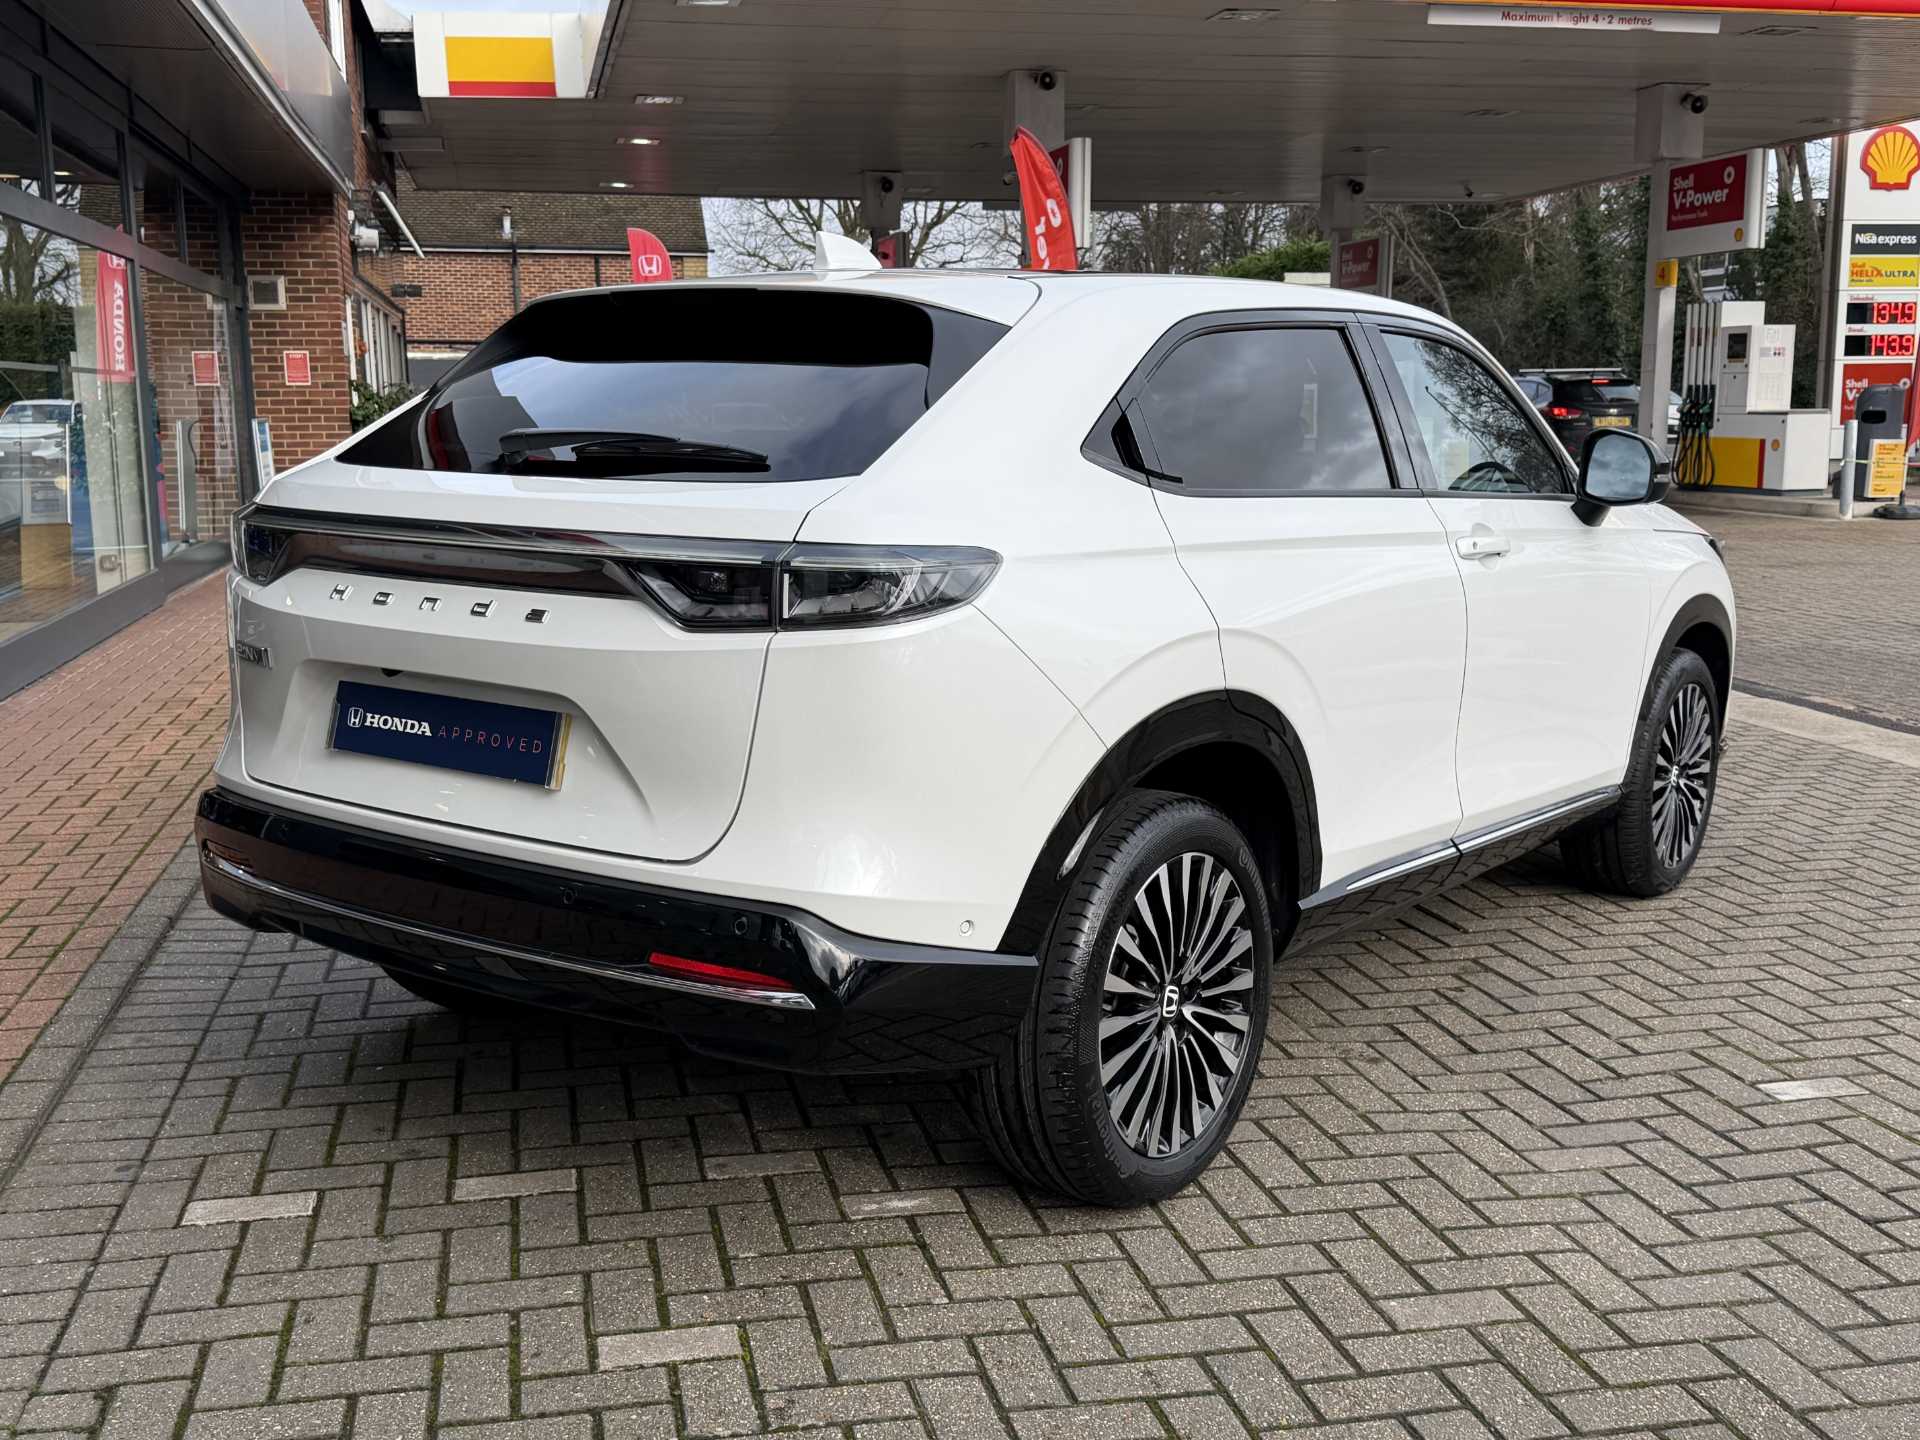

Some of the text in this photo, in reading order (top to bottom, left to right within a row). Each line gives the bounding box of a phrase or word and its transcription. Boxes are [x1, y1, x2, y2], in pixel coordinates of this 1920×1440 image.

[1501, 10, 1553, 22] Maximum
[1557, 11, 1589, 25] hight
[1617, 15, 1653, 26] metres
[1673, 173, 1694, 190] Shell
[1673, 188, 1729, 209] V-Power
[1884, 270, 1916, 278] ULTRA
[1872, 302, 1916, 324] 134.9
[1870, 334, 1914, 356] 143.9
[1845, 378, 1869, 389] Shell
[364, 711, 542, 753] HONDA APPROVED
